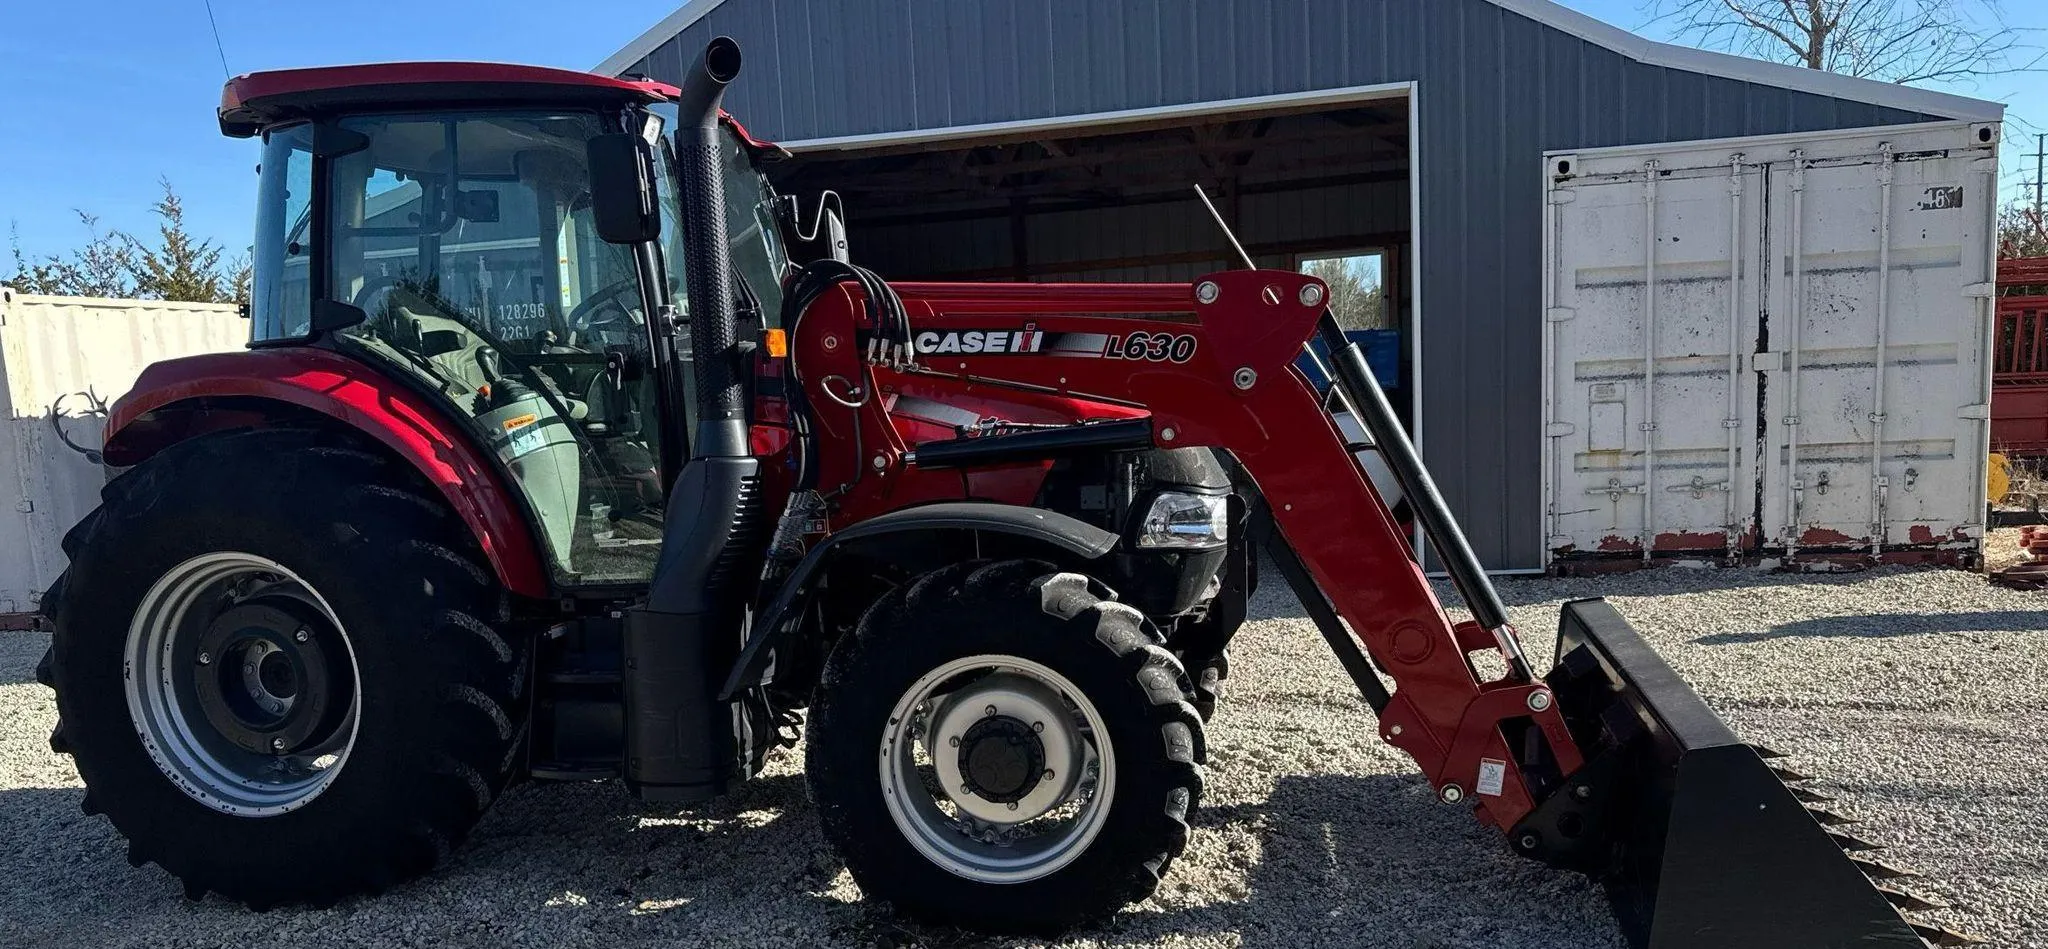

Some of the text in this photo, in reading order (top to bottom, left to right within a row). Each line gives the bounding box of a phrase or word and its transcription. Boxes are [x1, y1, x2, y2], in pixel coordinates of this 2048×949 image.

[500, 303, 545, 320] 128296
[915, 331, 1008, 353] CASE
[1104, 331, 1197, 364] L630
